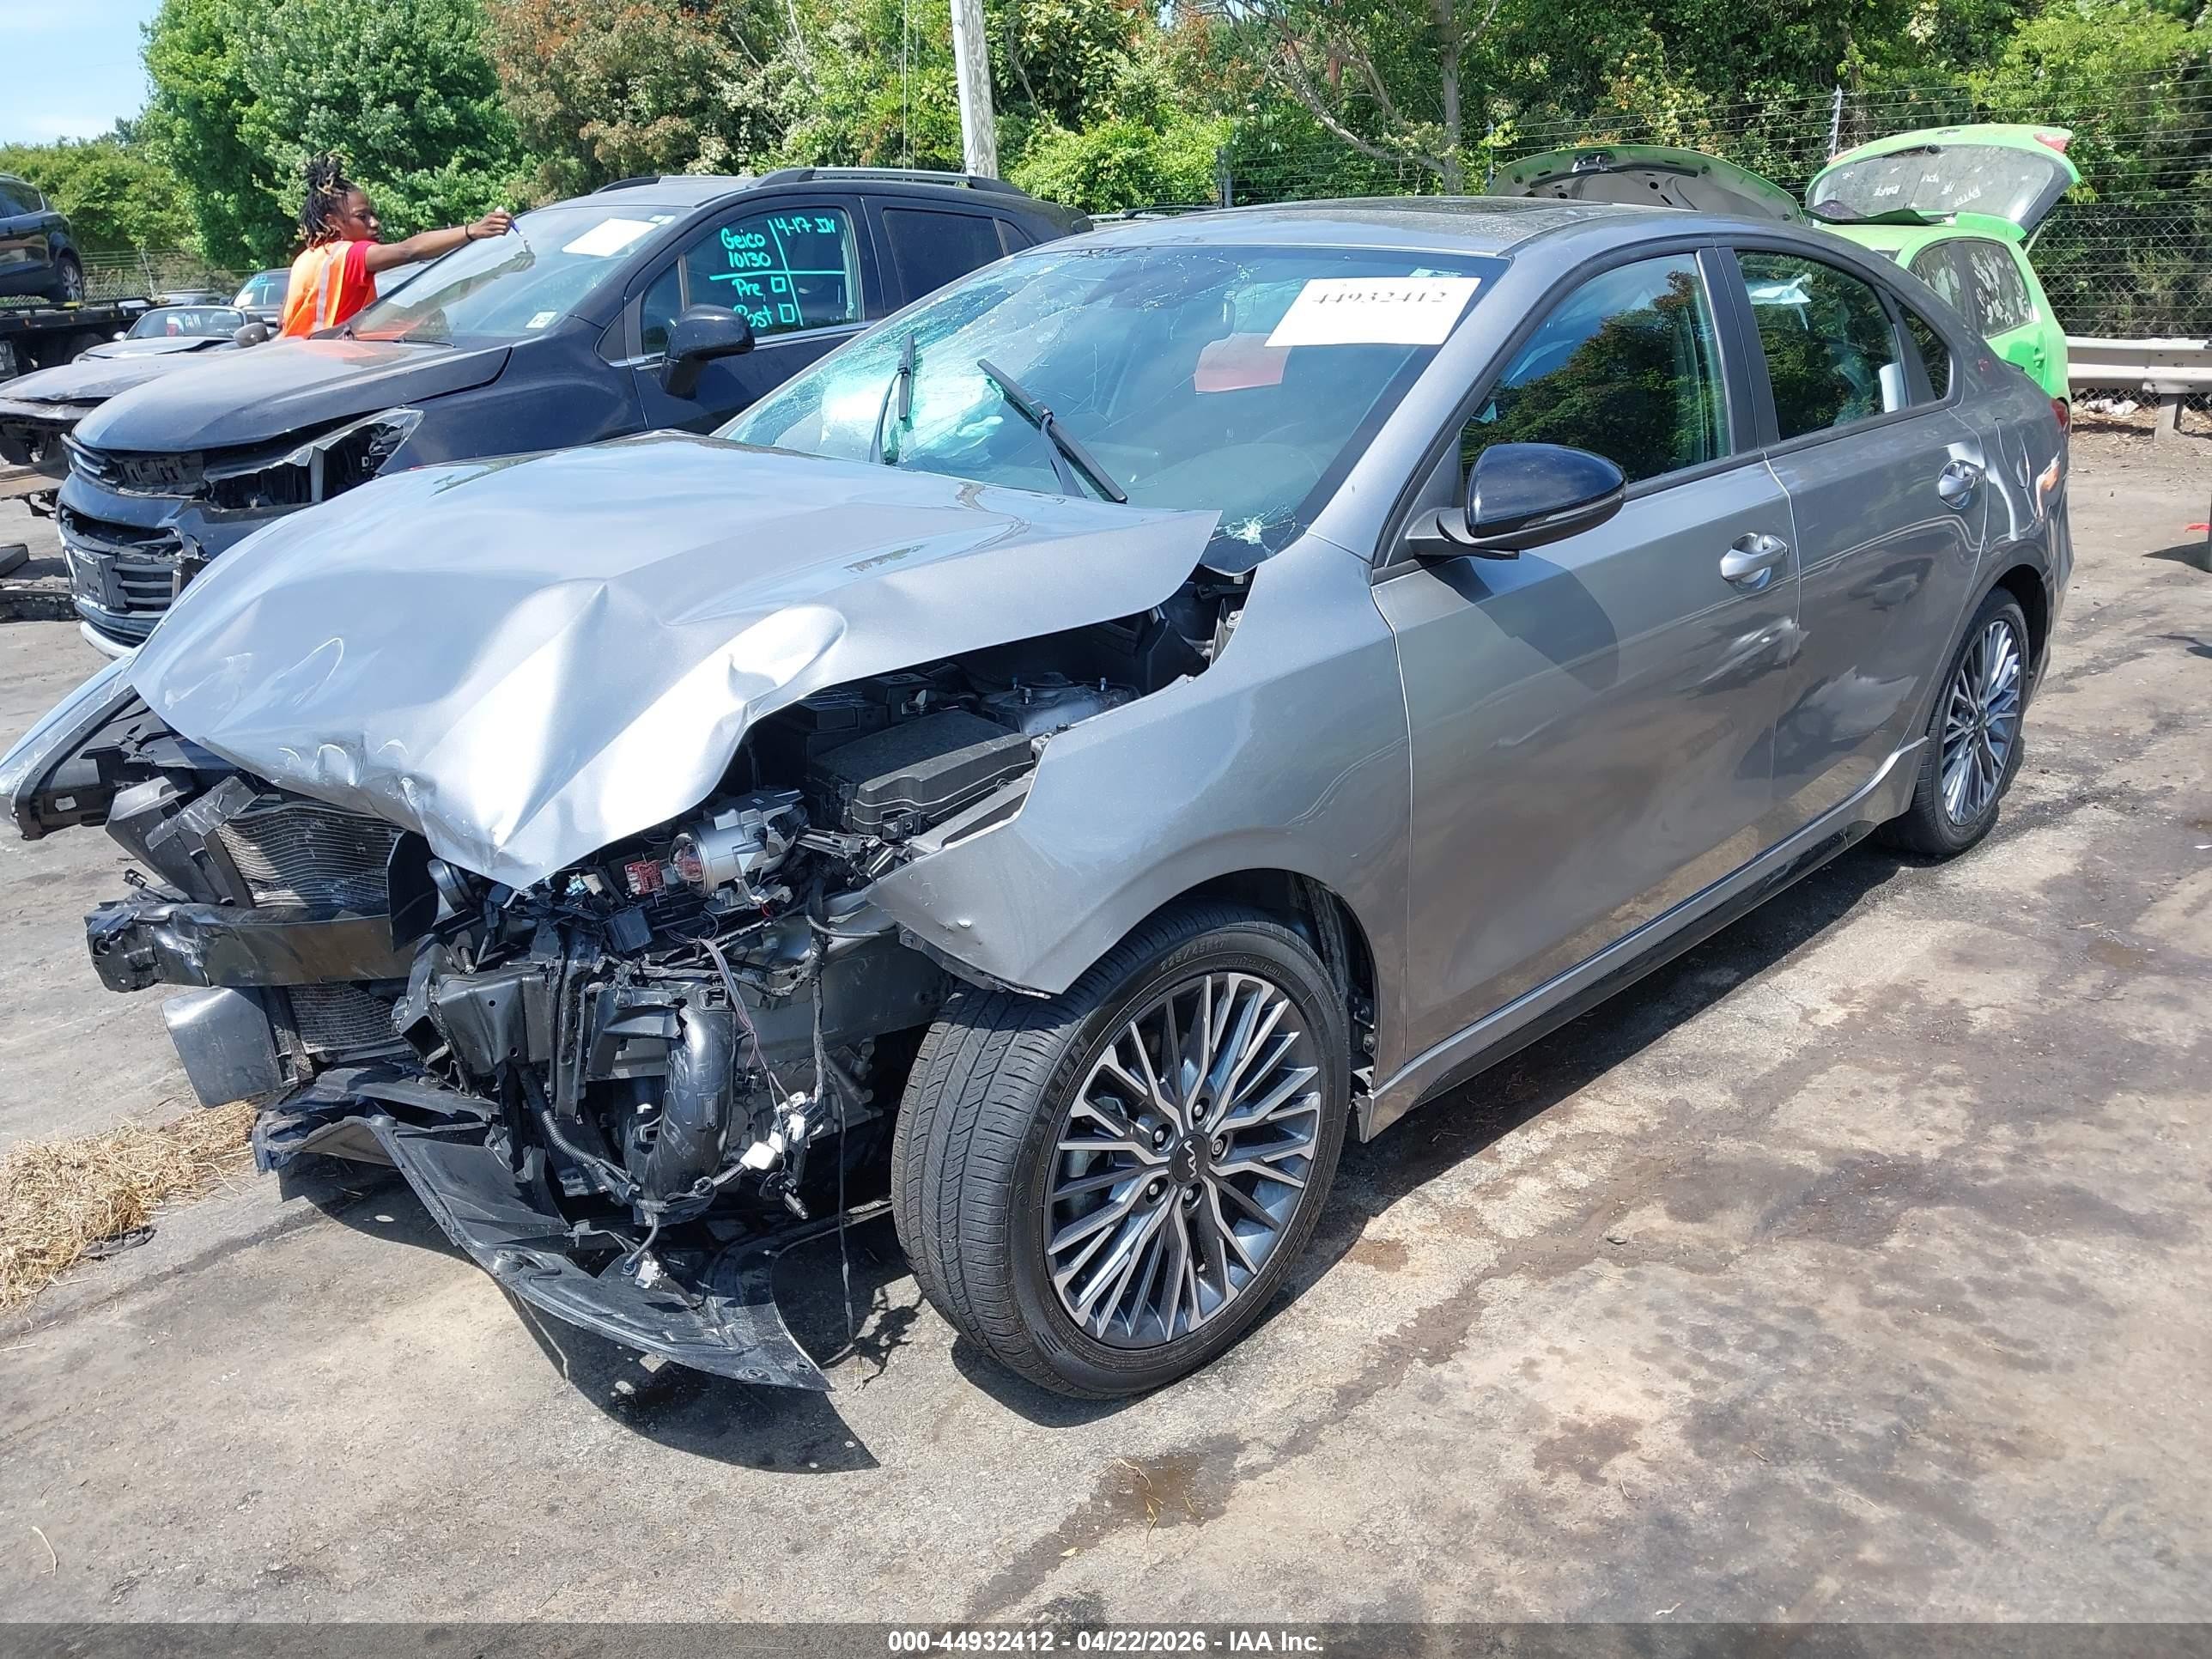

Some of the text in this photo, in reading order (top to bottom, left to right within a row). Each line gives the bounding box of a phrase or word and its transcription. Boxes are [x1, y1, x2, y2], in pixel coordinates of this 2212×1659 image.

[775, 216, 812, 237] 4-17
[720, 227, 766, 251] Geico
[728, 251, 772, 269] 10130
[732, 278, 763, 297] Pre
